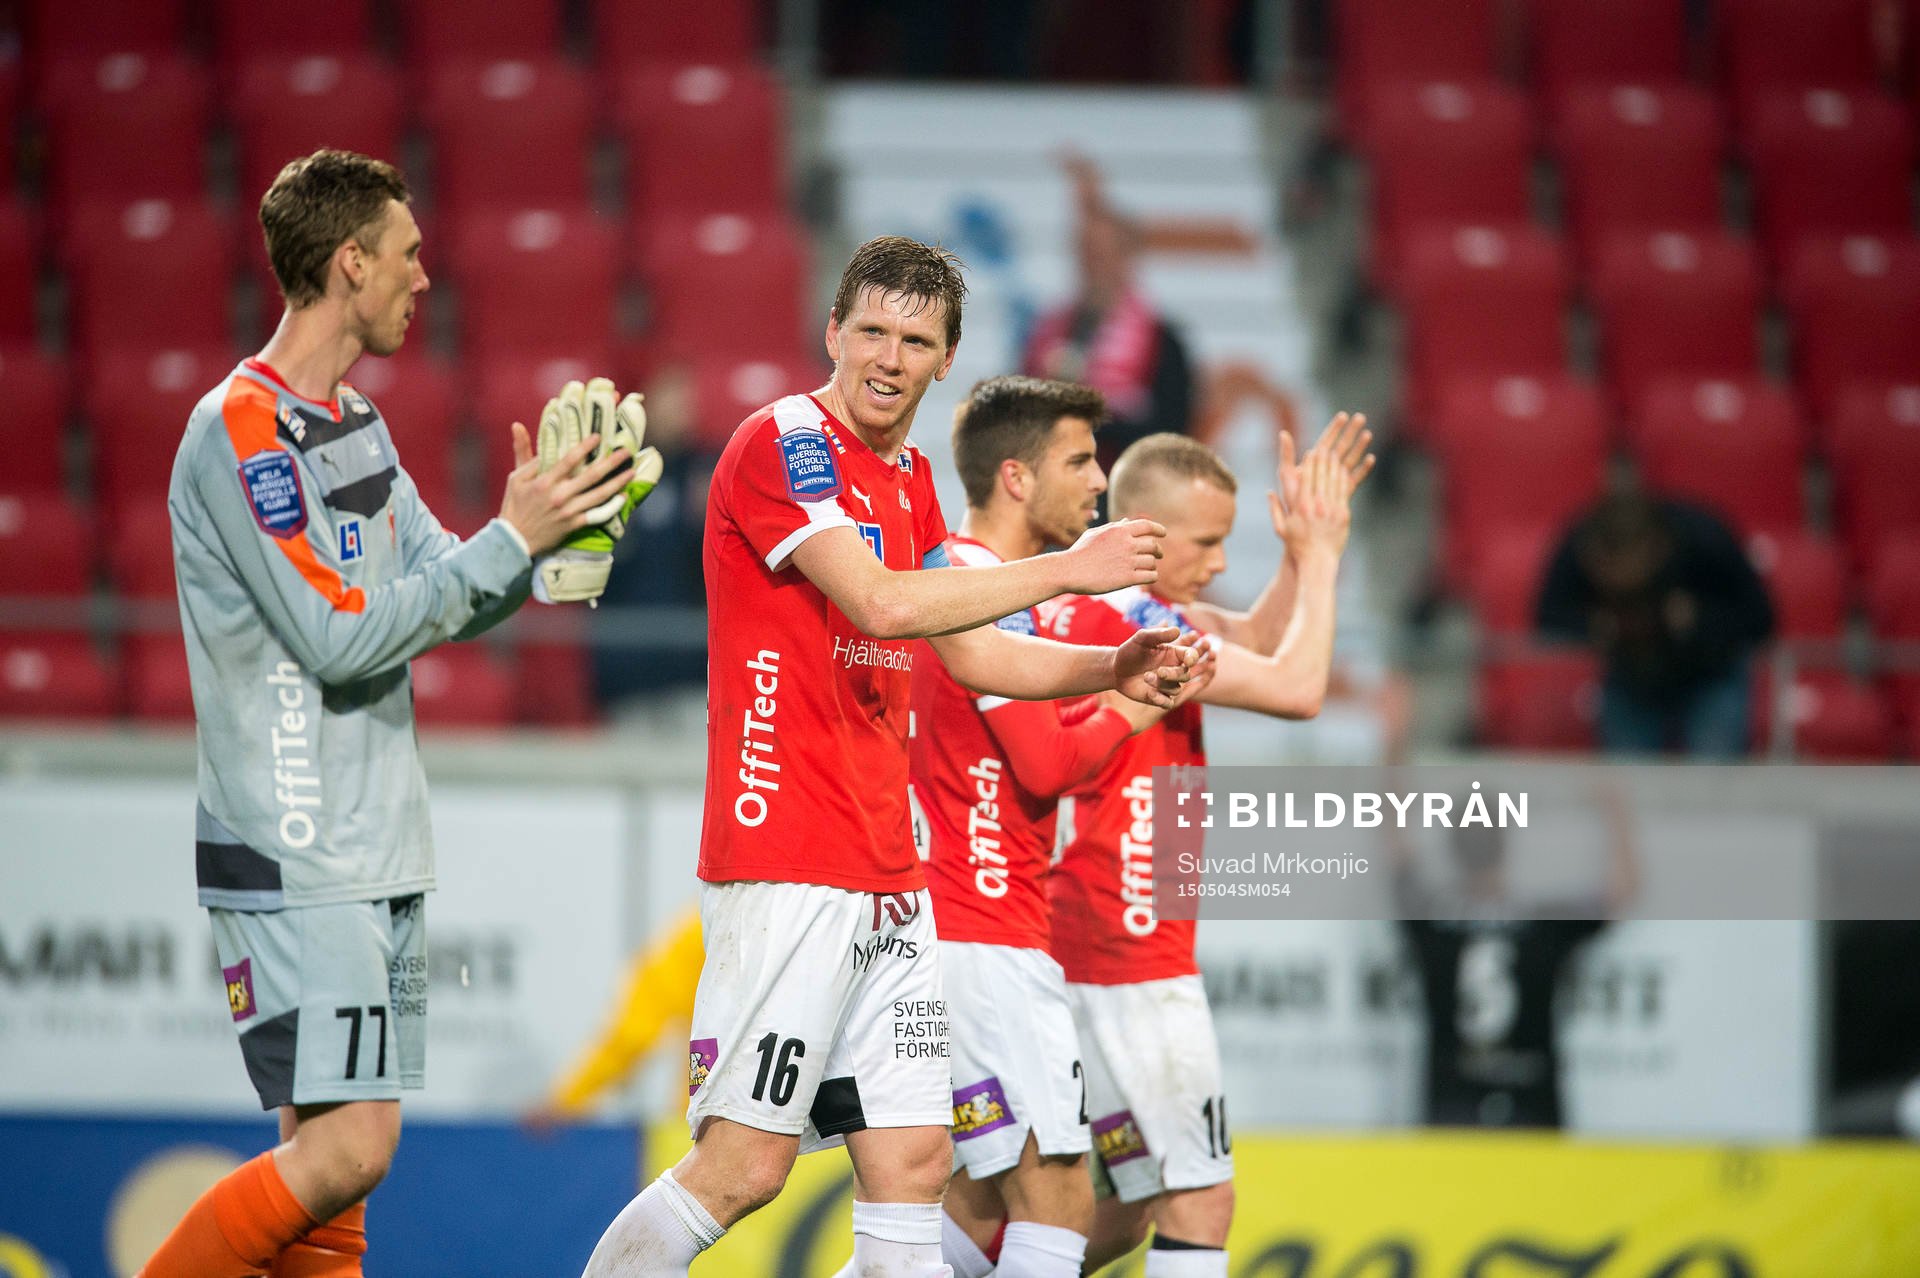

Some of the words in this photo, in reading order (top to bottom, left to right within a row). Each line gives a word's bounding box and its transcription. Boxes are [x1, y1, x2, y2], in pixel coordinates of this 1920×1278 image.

[788, 449, 828, 462] SVERIGES
[789, 457, 831, 471] FOTBOLLS
[795, 442, 817, 451] HELA
[797, 464, 825, 476] KLUBB
[266, 659, 322, 849] OffiTech
[734, 649, 781, 828] OffiTech
[1119, 774, 1159, 938] OffiTech
[335, 1006, 388, 1080] 77
[750, 1031, 806, 1107] 16
